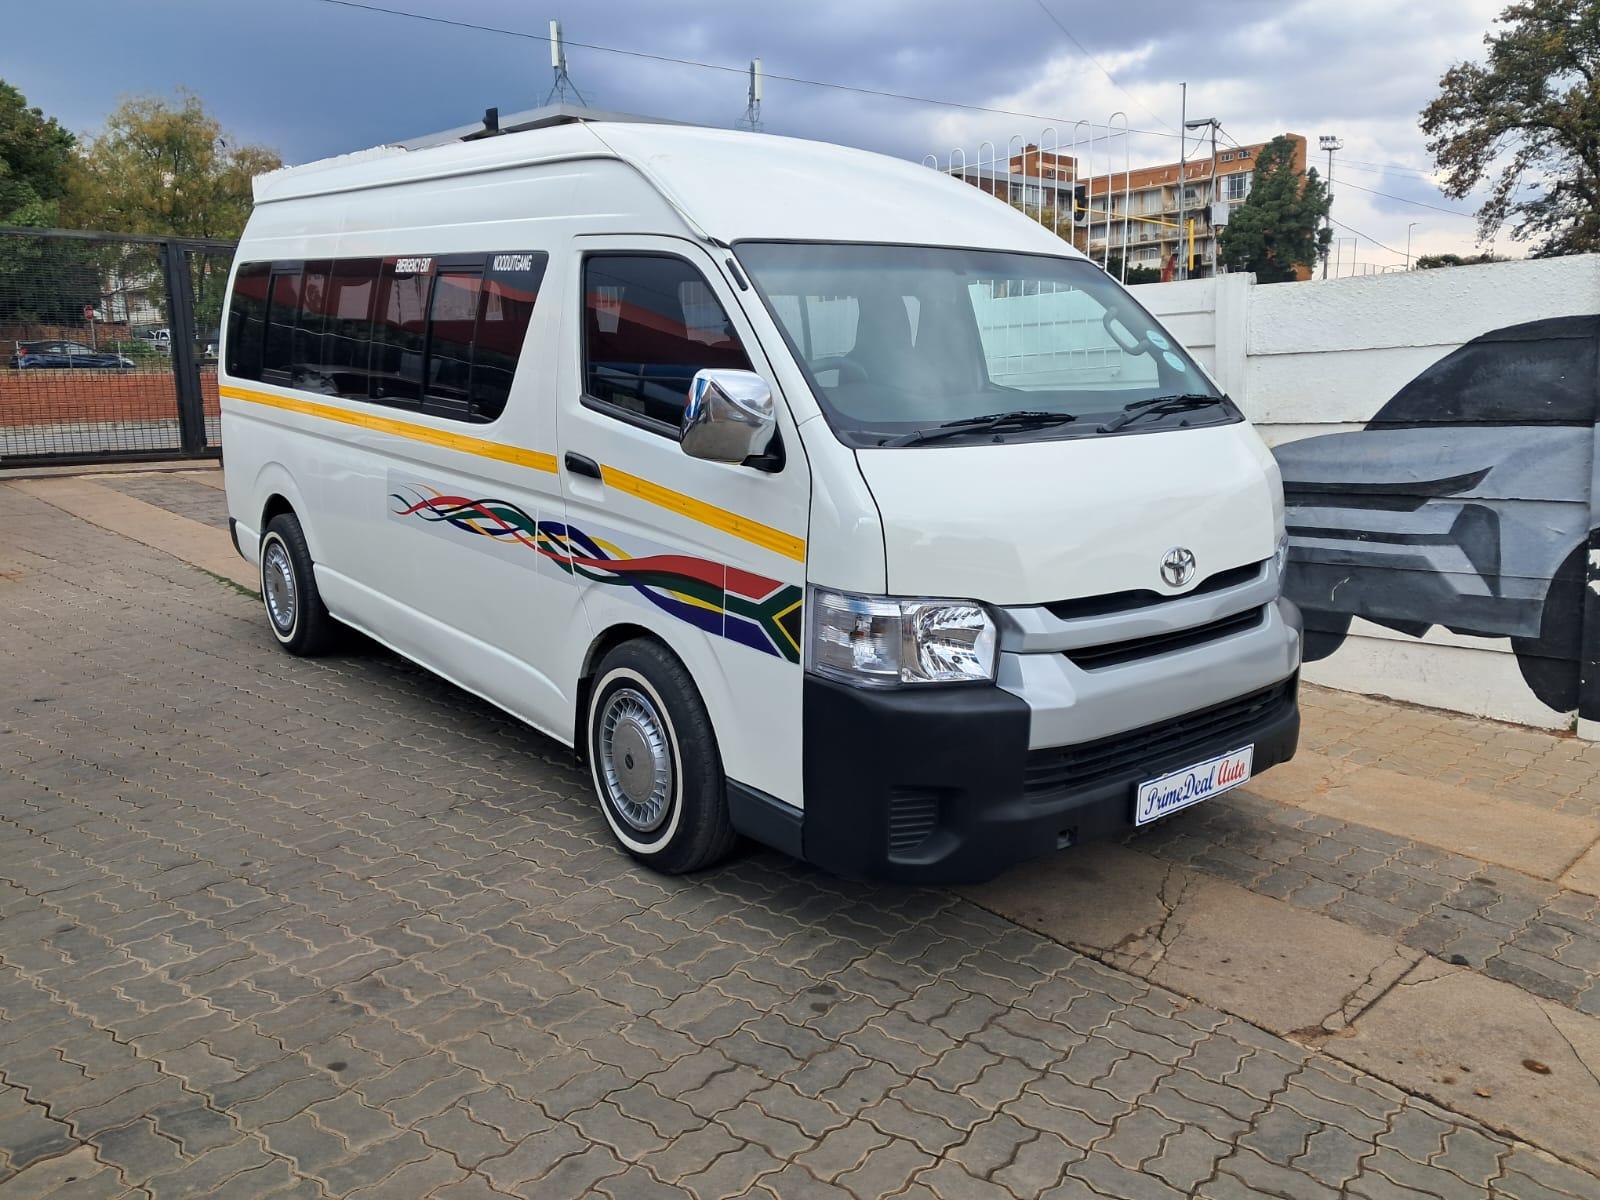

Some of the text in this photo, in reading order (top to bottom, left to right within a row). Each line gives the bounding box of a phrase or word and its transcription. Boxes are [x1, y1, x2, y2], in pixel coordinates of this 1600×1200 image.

[395, 257, 432, 273] EMERGENCY EXIT
[1217, 759, 1246, 786] Auto
